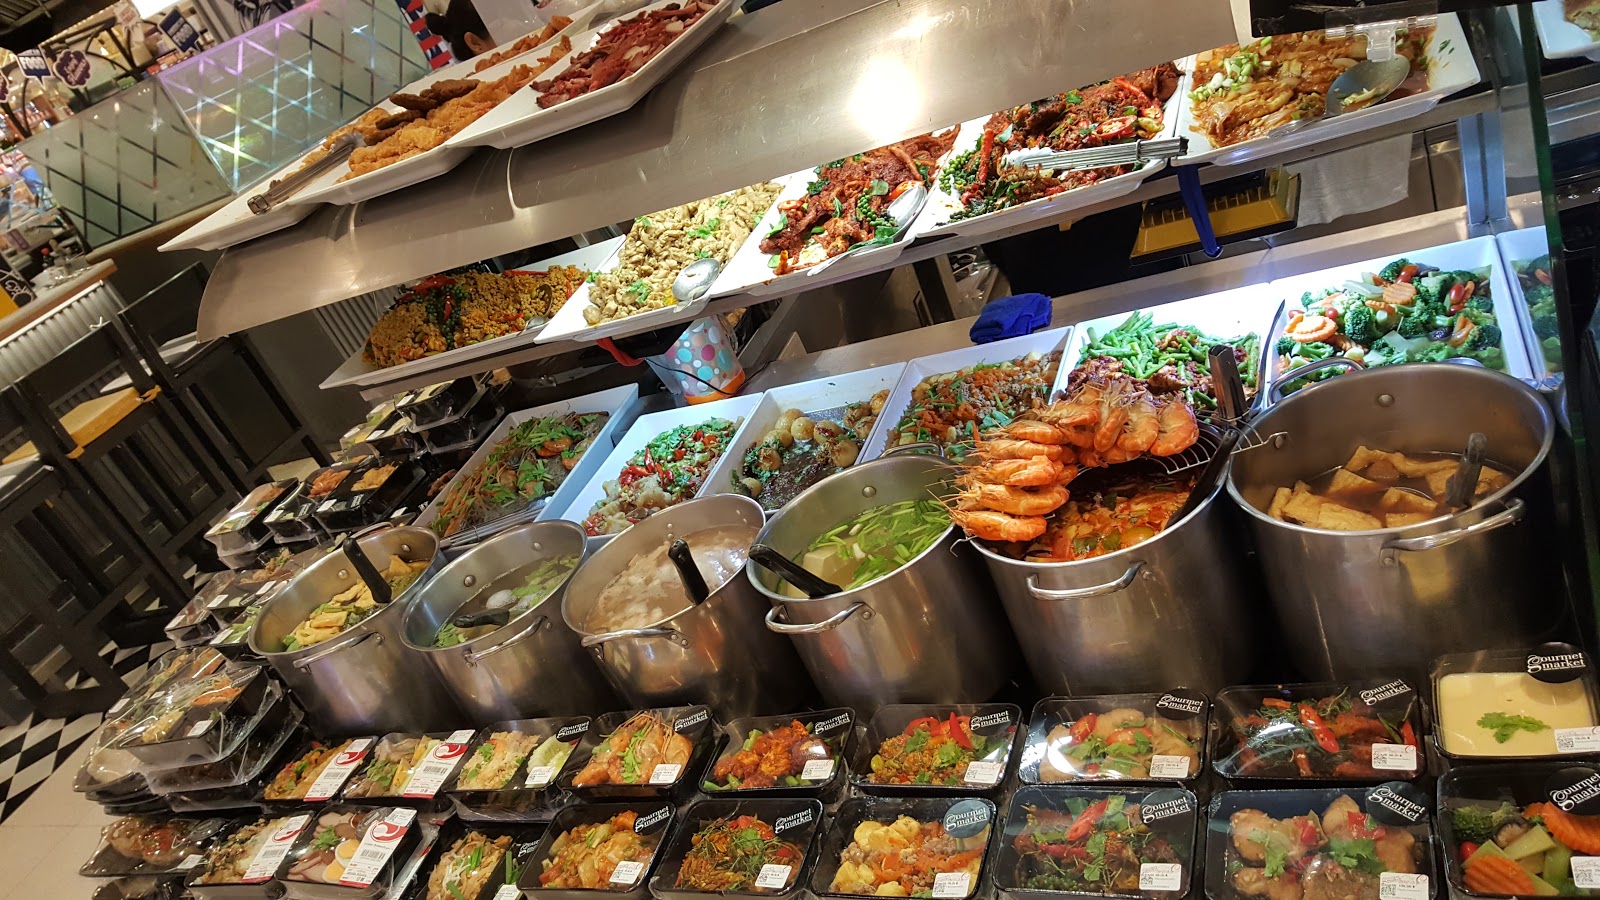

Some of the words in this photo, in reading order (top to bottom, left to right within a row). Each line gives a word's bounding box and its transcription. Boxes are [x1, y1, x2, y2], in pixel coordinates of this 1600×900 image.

[19, 56, 46, 70] FOOD
[1542, 659, 1586, 671] market
[1375, 684, 1411, 701] market
[1168, 701, 1202, 713] market
[980, 716, 1009, 727] market
[1154, 803, 1191, 820] market
[1380, 798, 1420, 821] market
[957, 813, 988, 828] market
